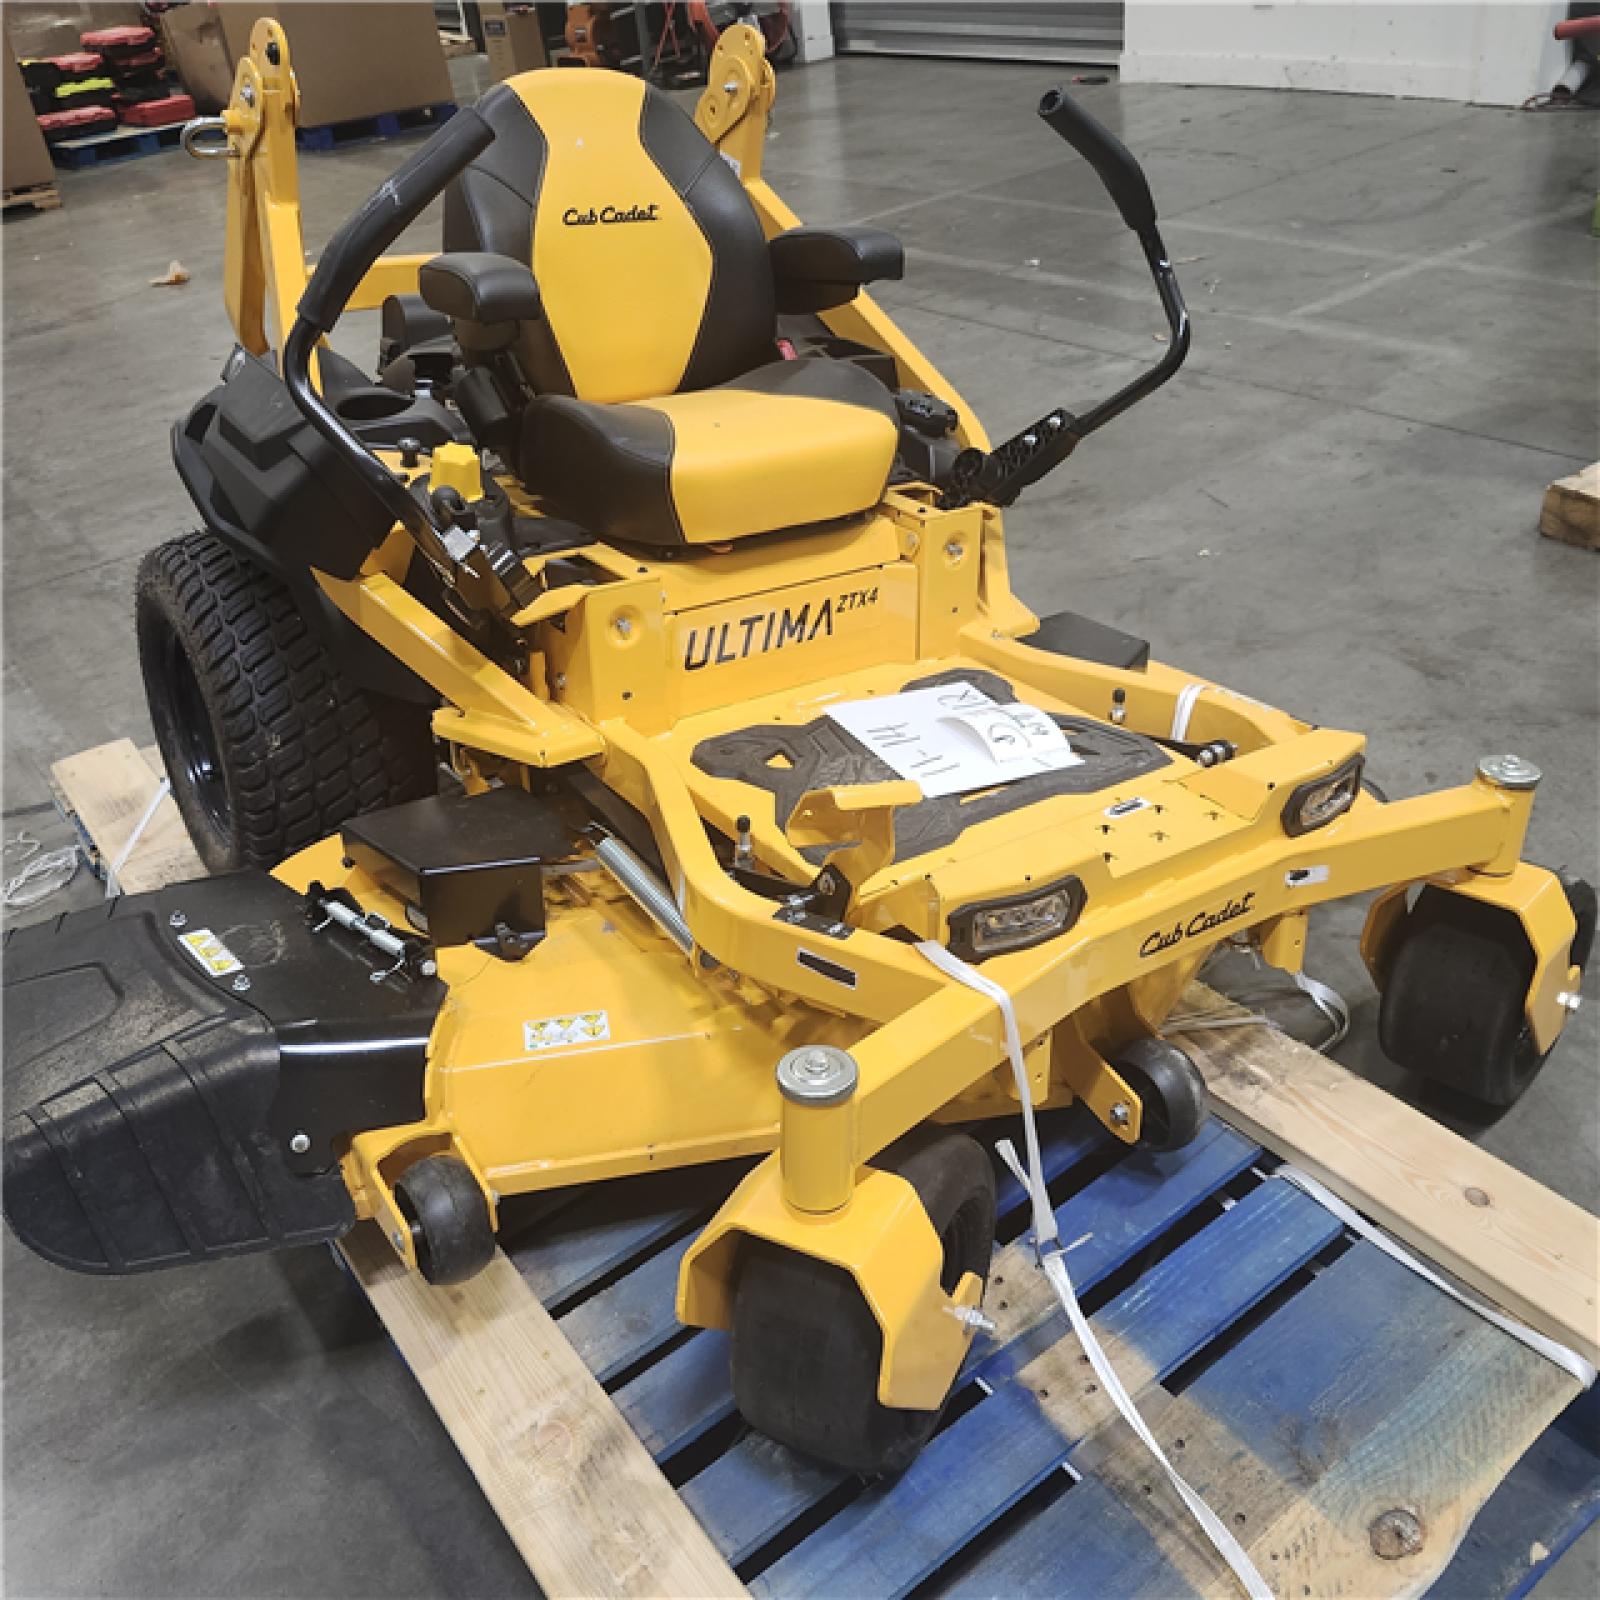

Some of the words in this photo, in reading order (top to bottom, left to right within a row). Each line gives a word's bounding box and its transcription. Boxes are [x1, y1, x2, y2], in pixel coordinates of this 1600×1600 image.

[562, 207, 598, 226] Cub
[600, 204, 660, 223] Cadet
[684, 597, 833, 671] ULTIMA
[835, 586, 879, 613] ZTX4
[1139, 921, 1184, 958] Cub
[1185, 892, 1256, 938] Cadet
